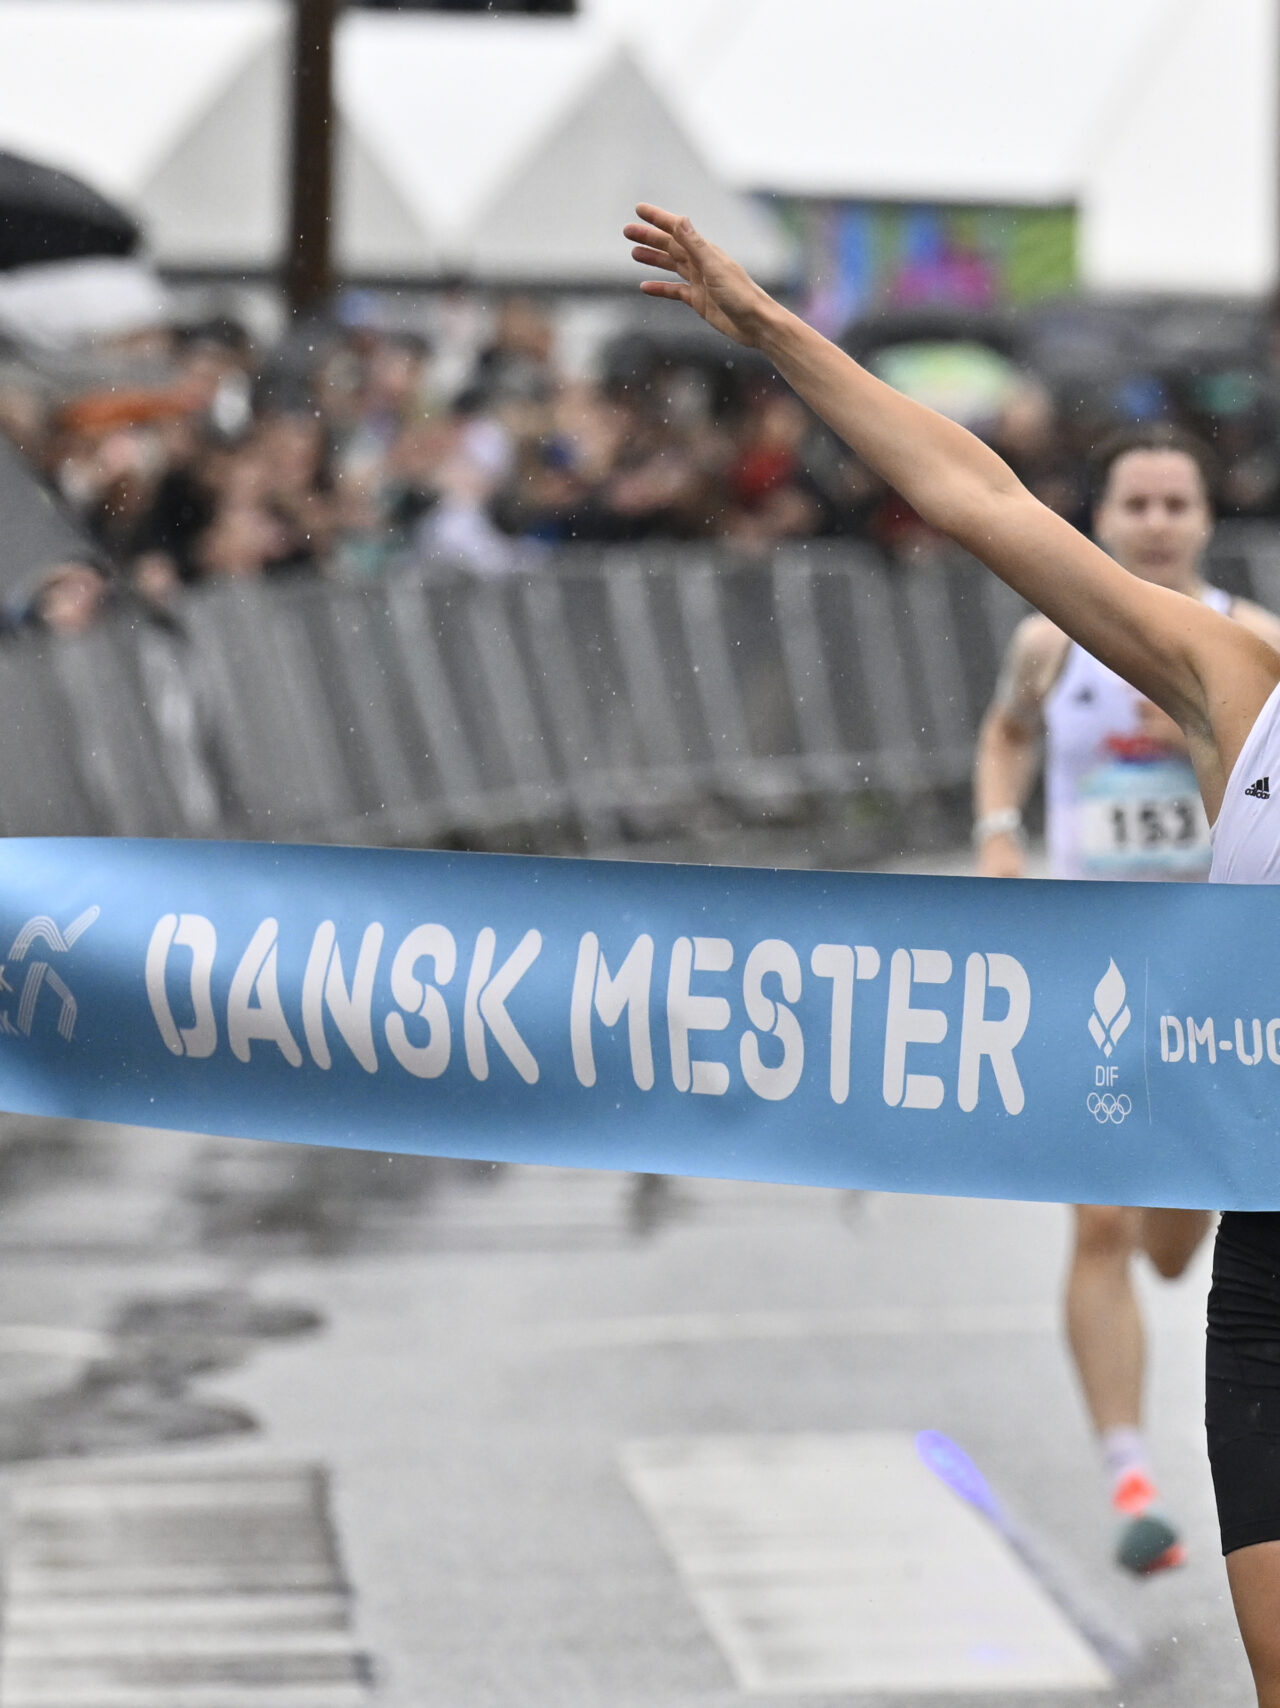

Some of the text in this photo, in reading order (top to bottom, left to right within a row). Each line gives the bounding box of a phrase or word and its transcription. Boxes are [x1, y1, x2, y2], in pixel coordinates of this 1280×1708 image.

[1244, 788, 1271, 800] adidas
[145, 913, 1032, 1115] DANSK MESTER
[1095, 1065, 1120, 1087] DIF
